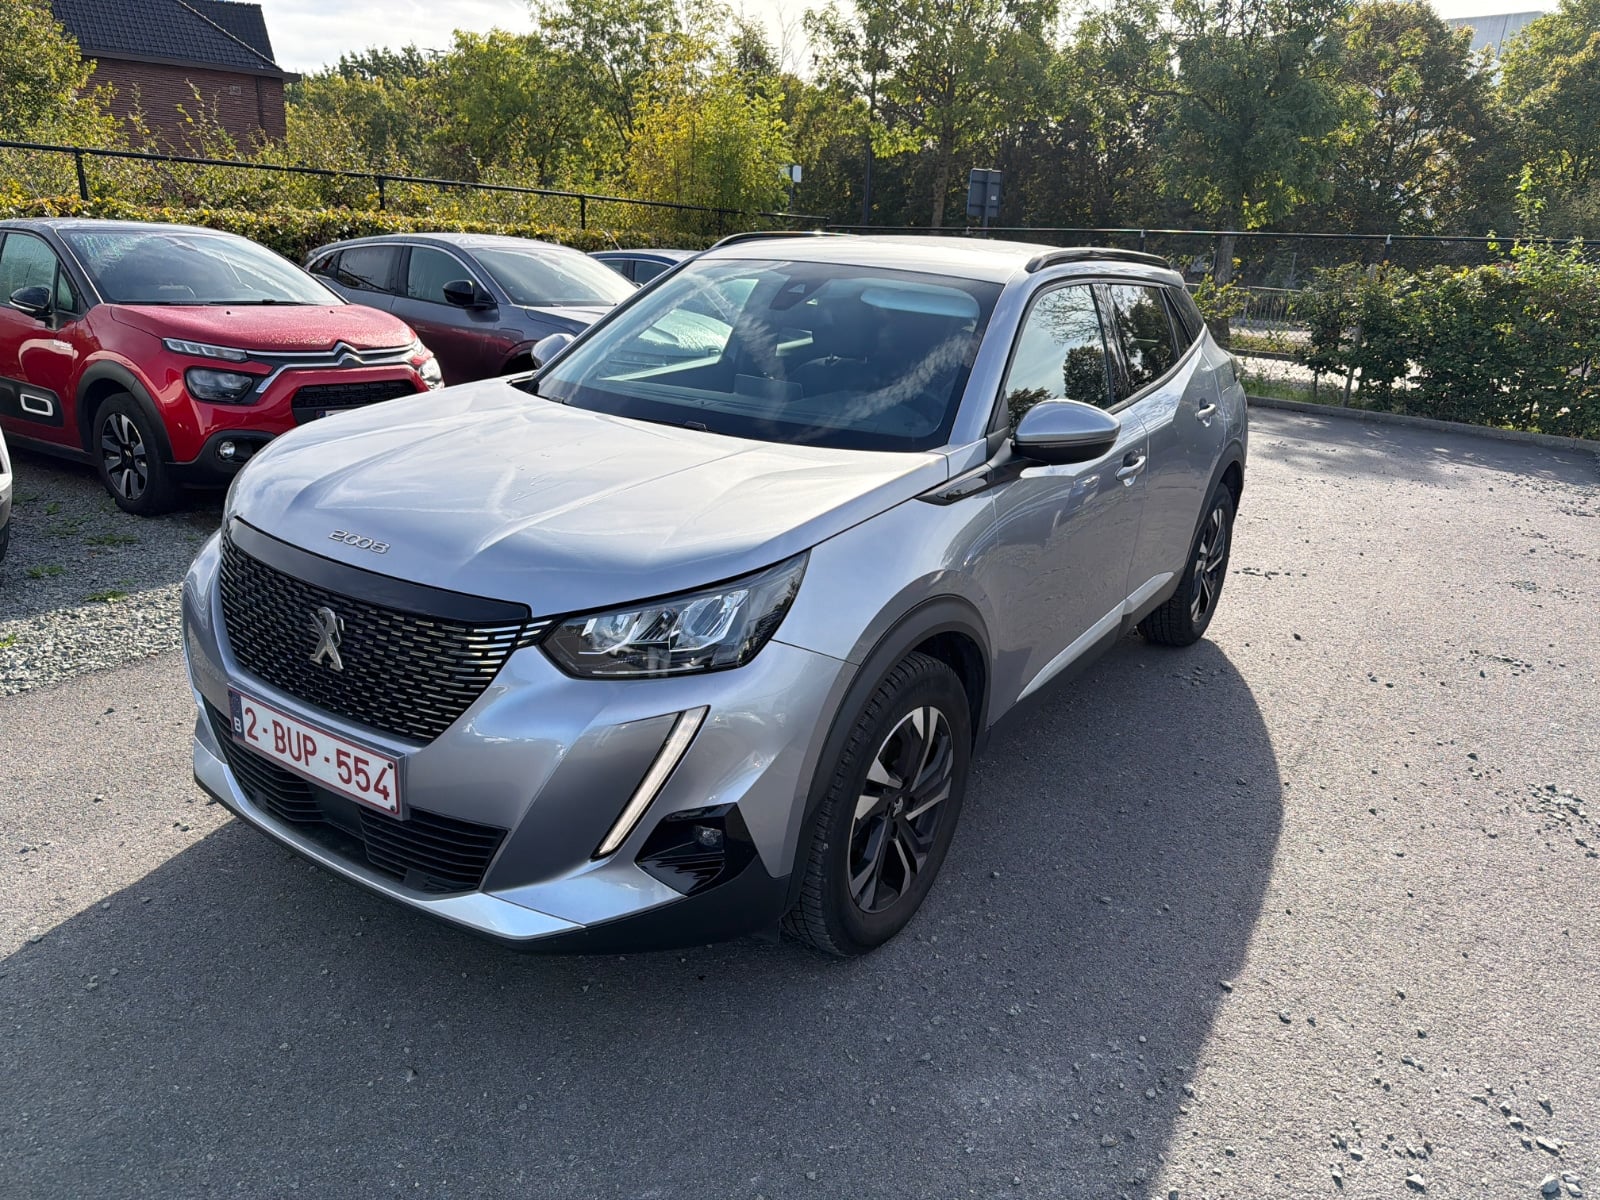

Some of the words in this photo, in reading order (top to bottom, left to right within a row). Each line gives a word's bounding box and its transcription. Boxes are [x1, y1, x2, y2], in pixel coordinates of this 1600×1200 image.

[328, 529, 390, 554] 2008
[233, 716, 242, 733] B
[244, 706, 390, 801] 2-BUP-554
